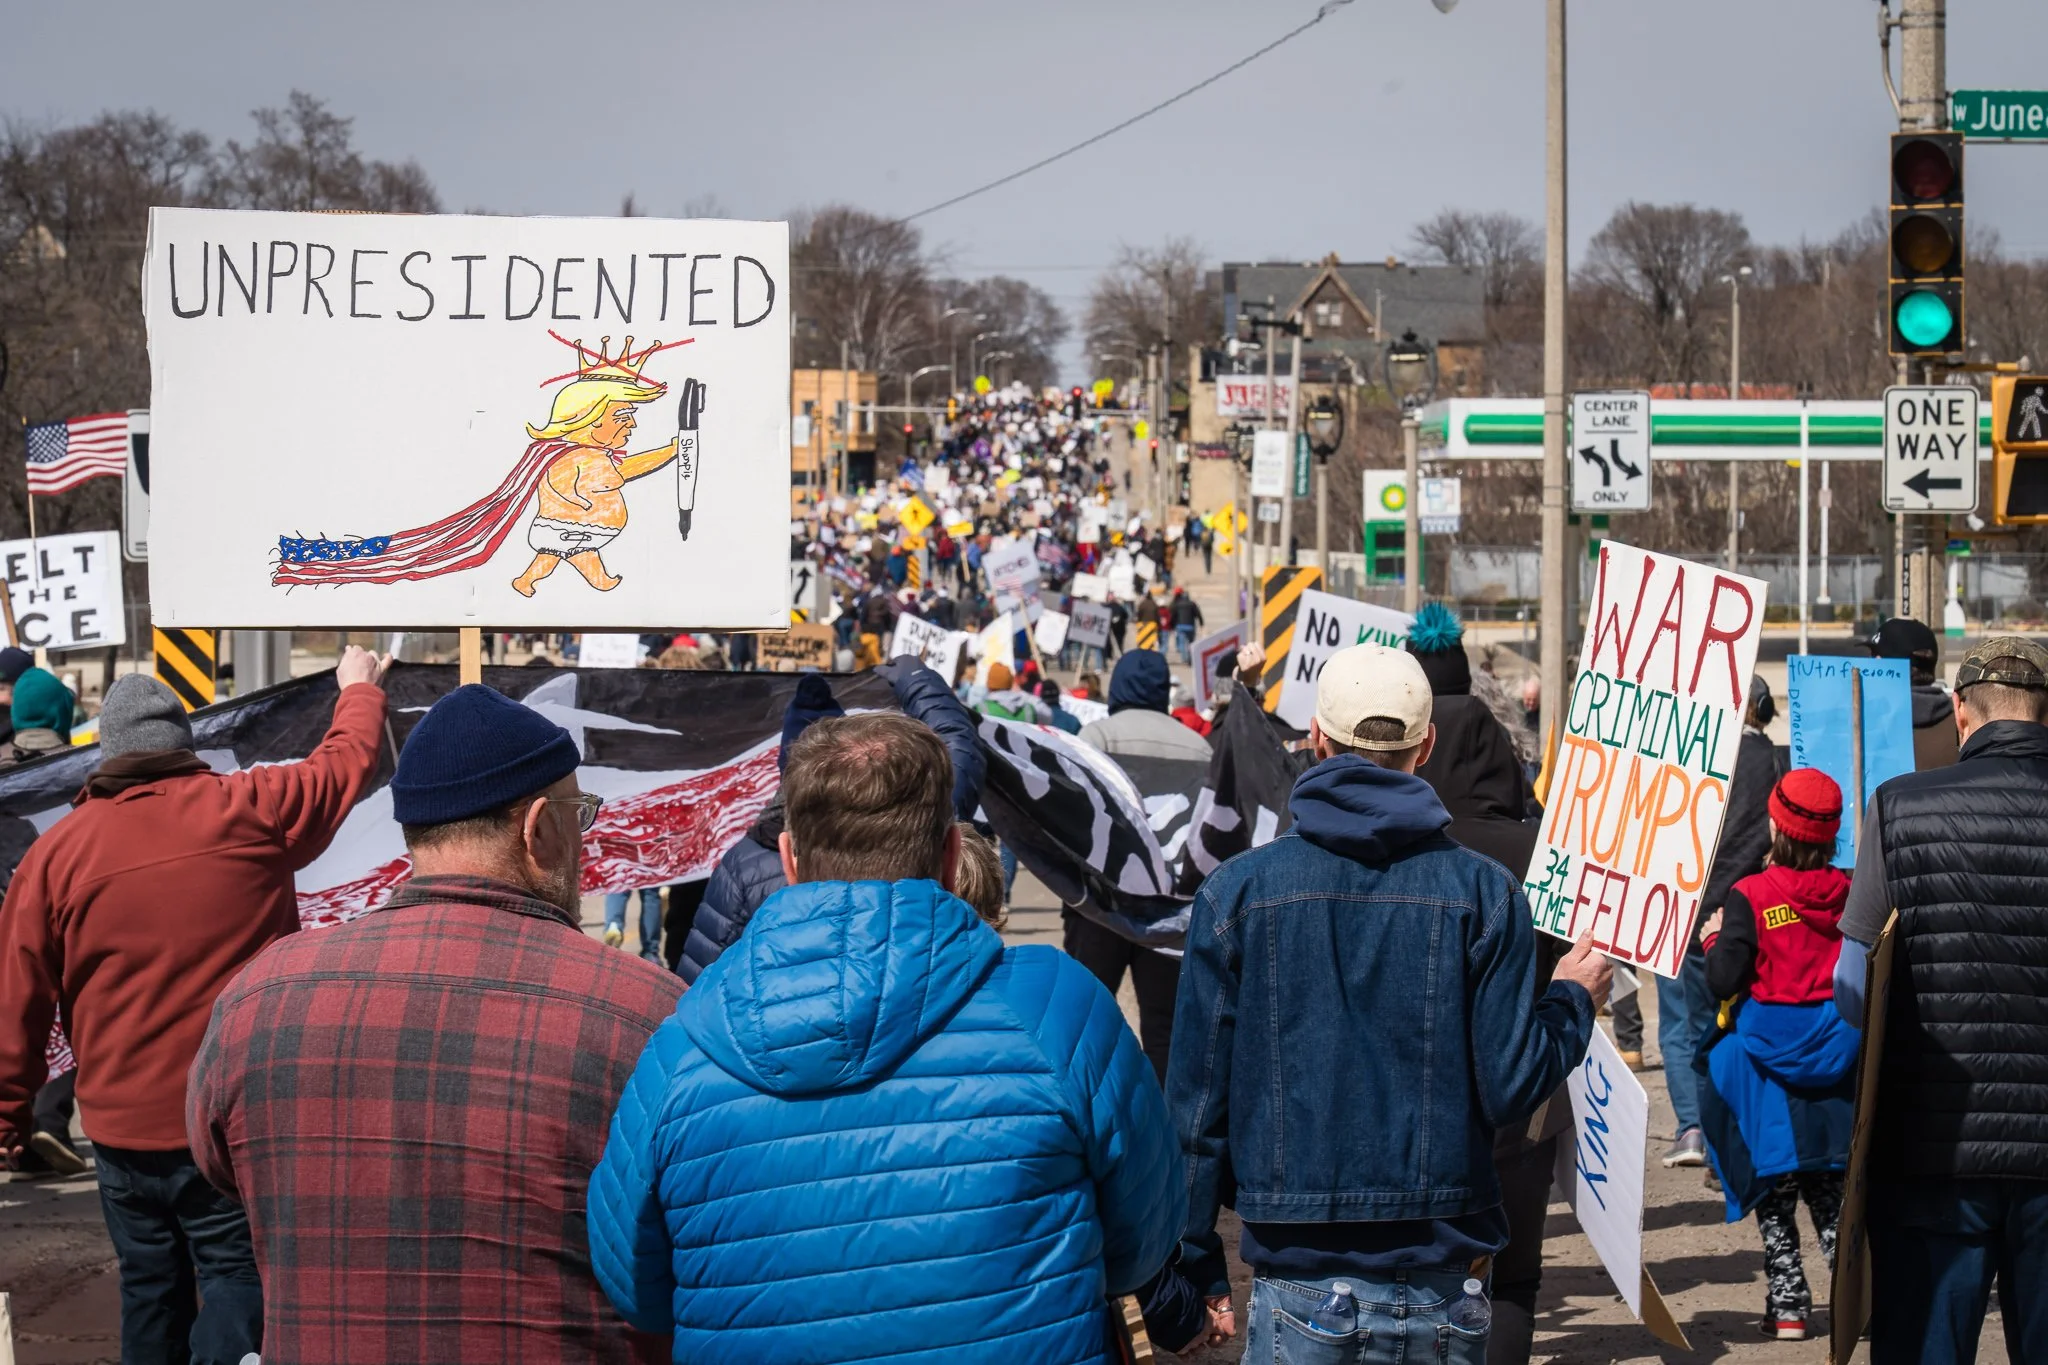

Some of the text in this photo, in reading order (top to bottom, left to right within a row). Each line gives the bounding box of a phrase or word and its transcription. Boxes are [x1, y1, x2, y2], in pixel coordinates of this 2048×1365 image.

[1971, 96, 2048, 131] June
[169, 240, 775, 328] UNPRESIDENTED
[1584, 401, 1638, 412] CENTER
[1592, 416, 1631, 426] LANE
[1898, 399, 1965, 426] ONE
[1898, 433, 1967, 460] WAY
[1592, 491, 1629, 503] ONLY
[9, 585, 77, 604] HE
[16, 609, 101, 647] CE
[1305, 608, 1340, 647] NO
[1591, 547, 1753, 717] WAR
[1296, 653, 1328, 684] N
[1569, 670, 1729, 781] CRIMINAL
[1547, 733, 1724, 893] TRUMPS
[1539, 848, 1571, 892] 34
[1567, 862, 1697, 977] FELON
[1575, 1053, 1612, 1212] KING
